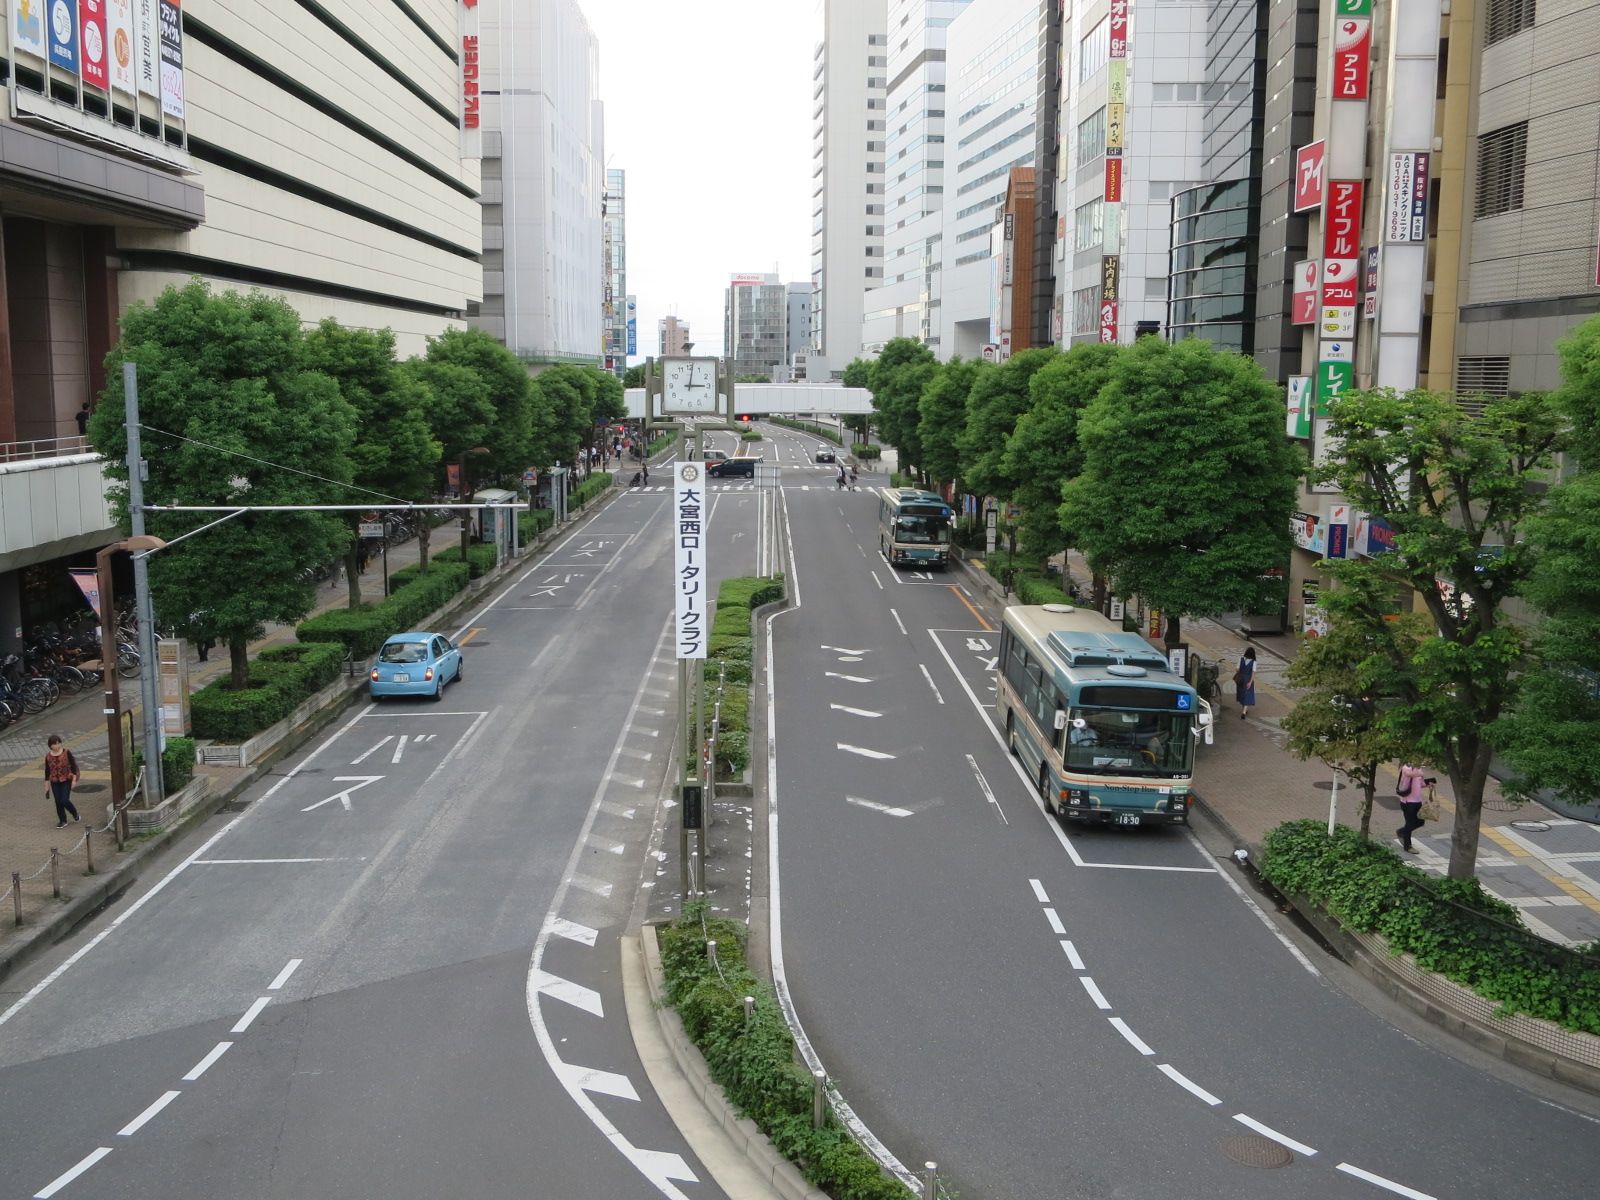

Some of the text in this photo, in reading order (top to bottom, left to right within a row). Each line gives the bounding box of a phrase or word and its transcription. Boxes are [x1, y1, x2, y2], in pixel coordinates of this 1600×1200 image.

[1111, 38, 1126, 50] 6F
[1343, 54, 1359, 95] アコム
[1333, 184, 1354, 255] アイフル
[1104, 257, 1116, 299] 山内農場
[1325, 288, 1353, 298] アコム
[529, 574, 584, 597] バス
[679, 488, 701, 655] 大宮西ロータリークラブ
[300, 734, 438, 812] バス
